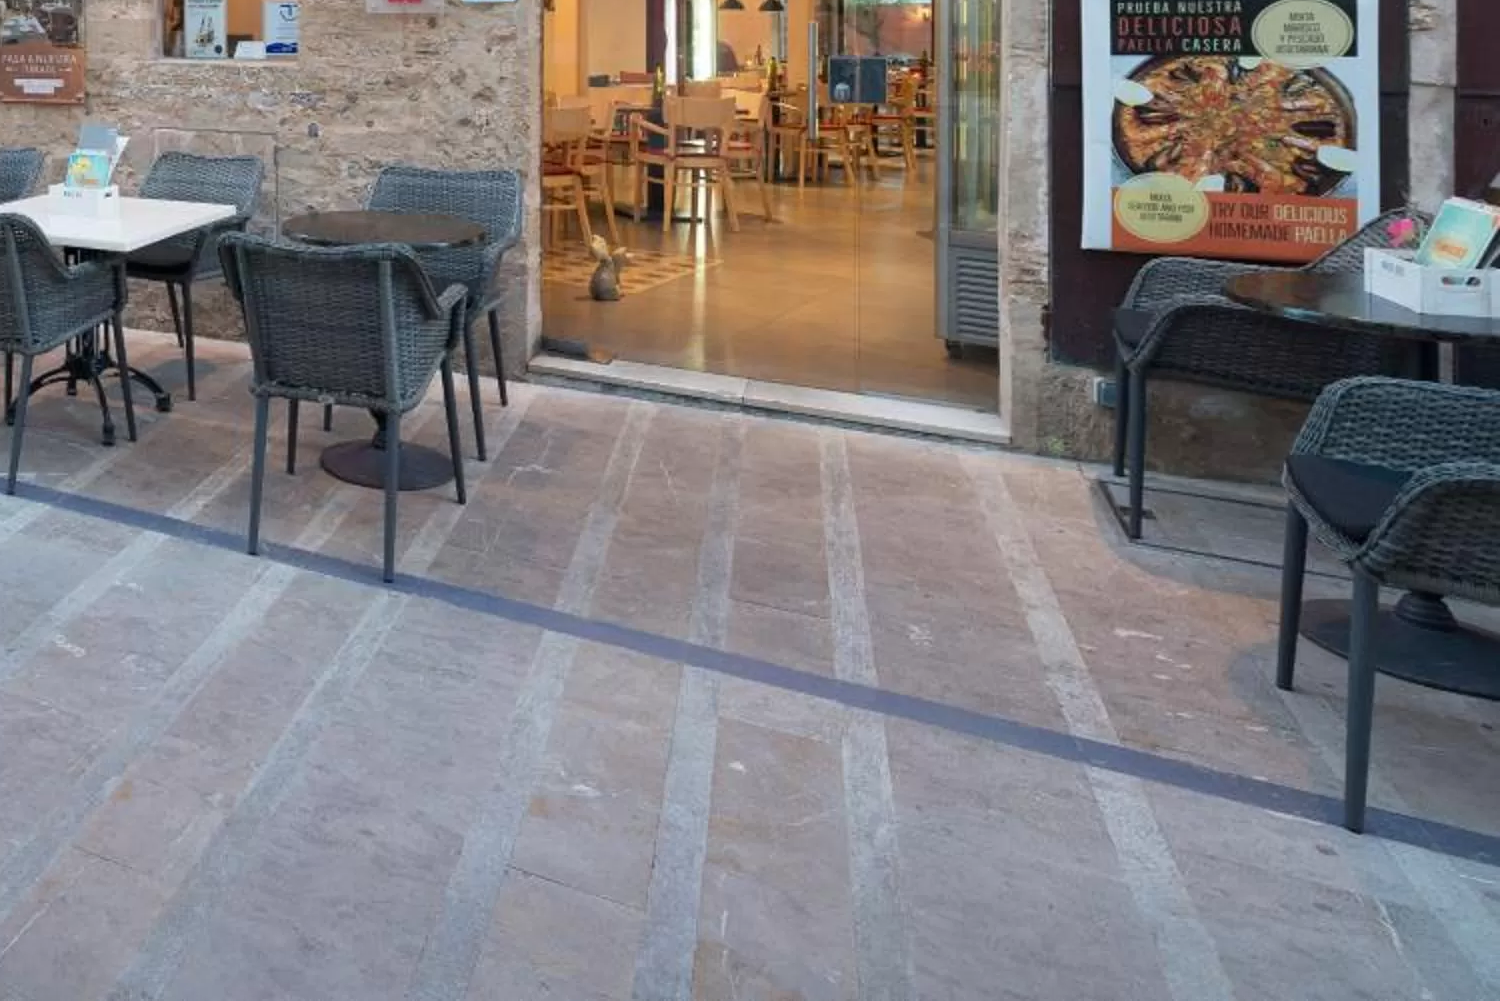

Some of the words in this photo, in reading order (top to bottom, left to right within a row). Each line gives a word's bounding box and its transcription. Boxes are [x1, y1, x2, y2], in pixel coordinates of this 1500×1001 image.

[1117, 1, 1170, 14] PRUEBA
[1177, 0, 1242, 14] NUESTRA
[1118, 15, 1242, 36] DELICIOSA
[1118, 38, 1174, 52] PAELLA
[1181, 38, 1242, 52] CASERA
[1211, 202, 1237, 219] TRY
[1239, 203, 1269, 220] OUR
[1273, 203, 1347, 224] DELICIOUS
[1208, 222, 1291, 242] HOMEMADE
[1294, 225, 1347, 245] PAELLA
